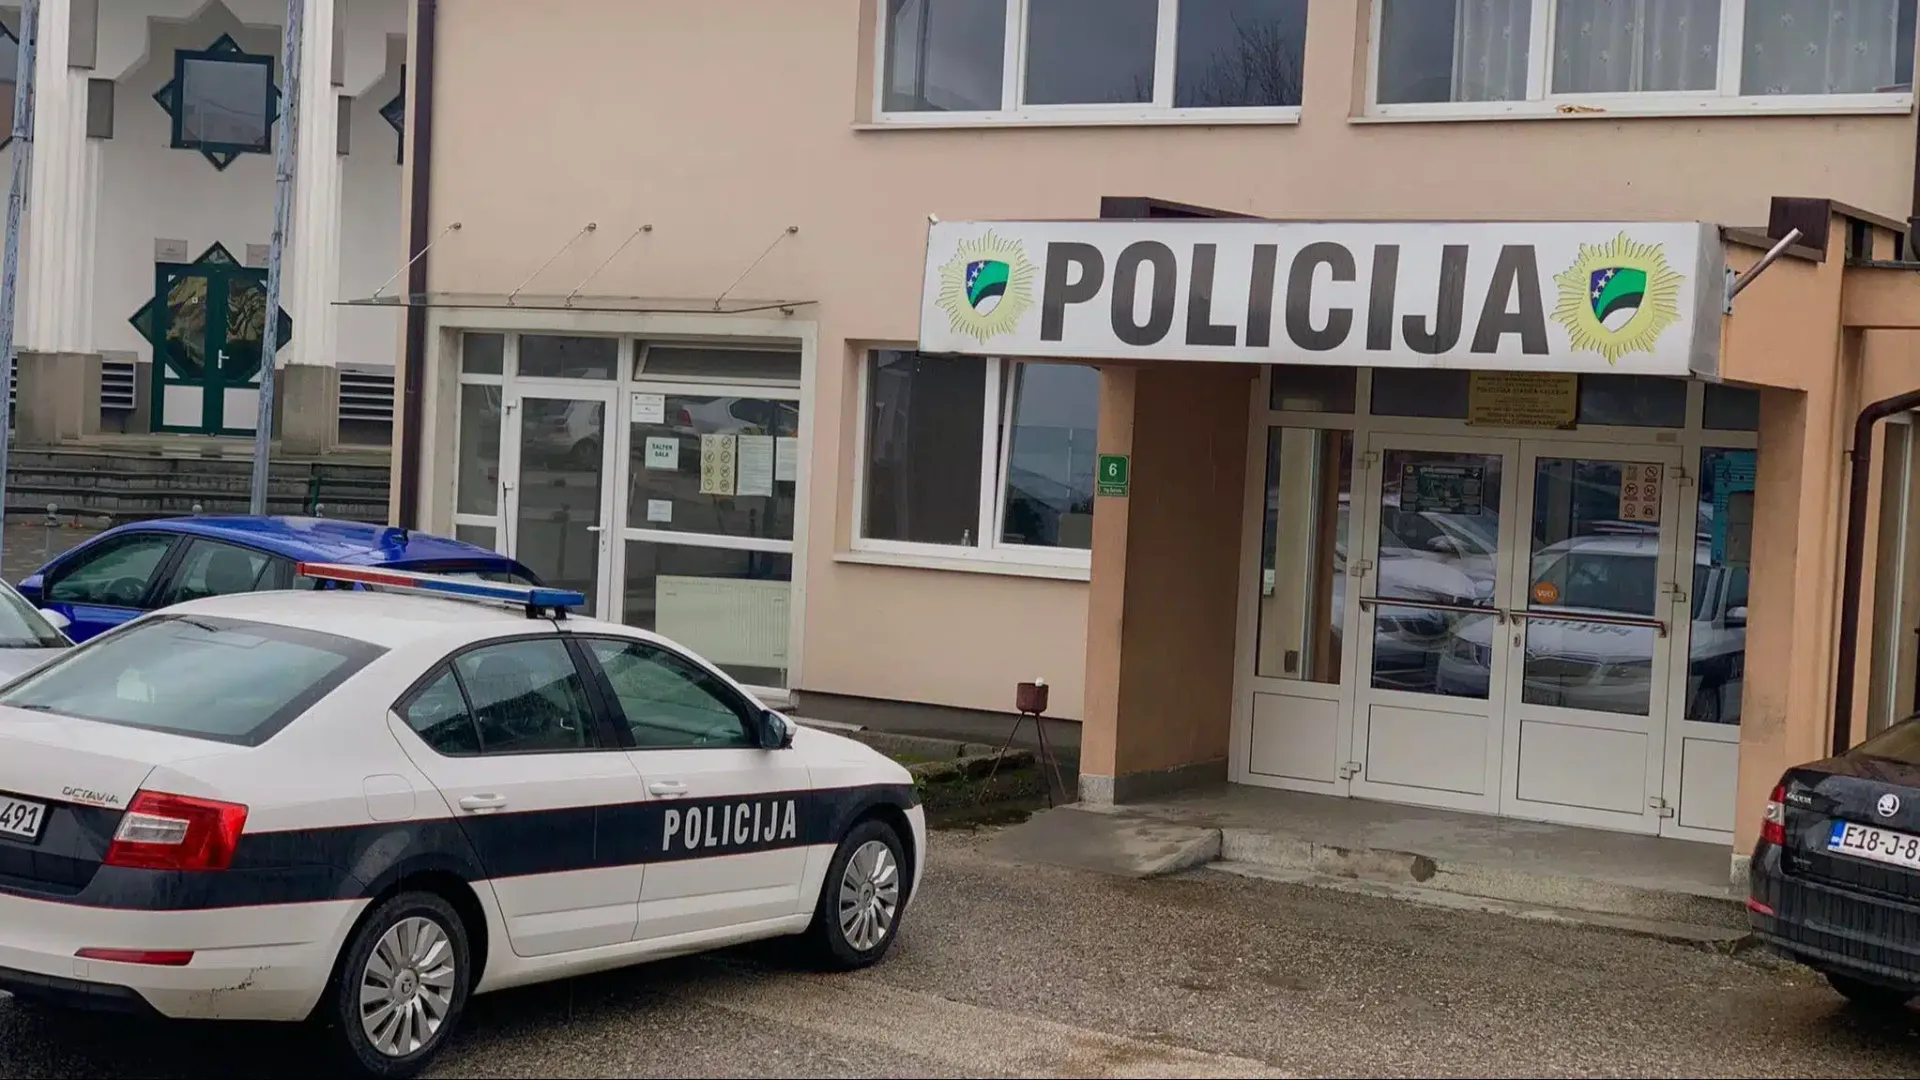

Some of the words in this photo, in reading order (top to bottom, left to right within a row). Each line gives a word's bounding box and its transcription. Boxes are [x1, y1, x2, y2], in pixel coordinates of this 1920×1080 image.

[1039, 240, 1551, 356] POLICIJA
[1109, 463, 1118, 477] 6
[62, 786, 119, 804] OCTAVIA
[662, 800, 797, 852] POLICIJA
